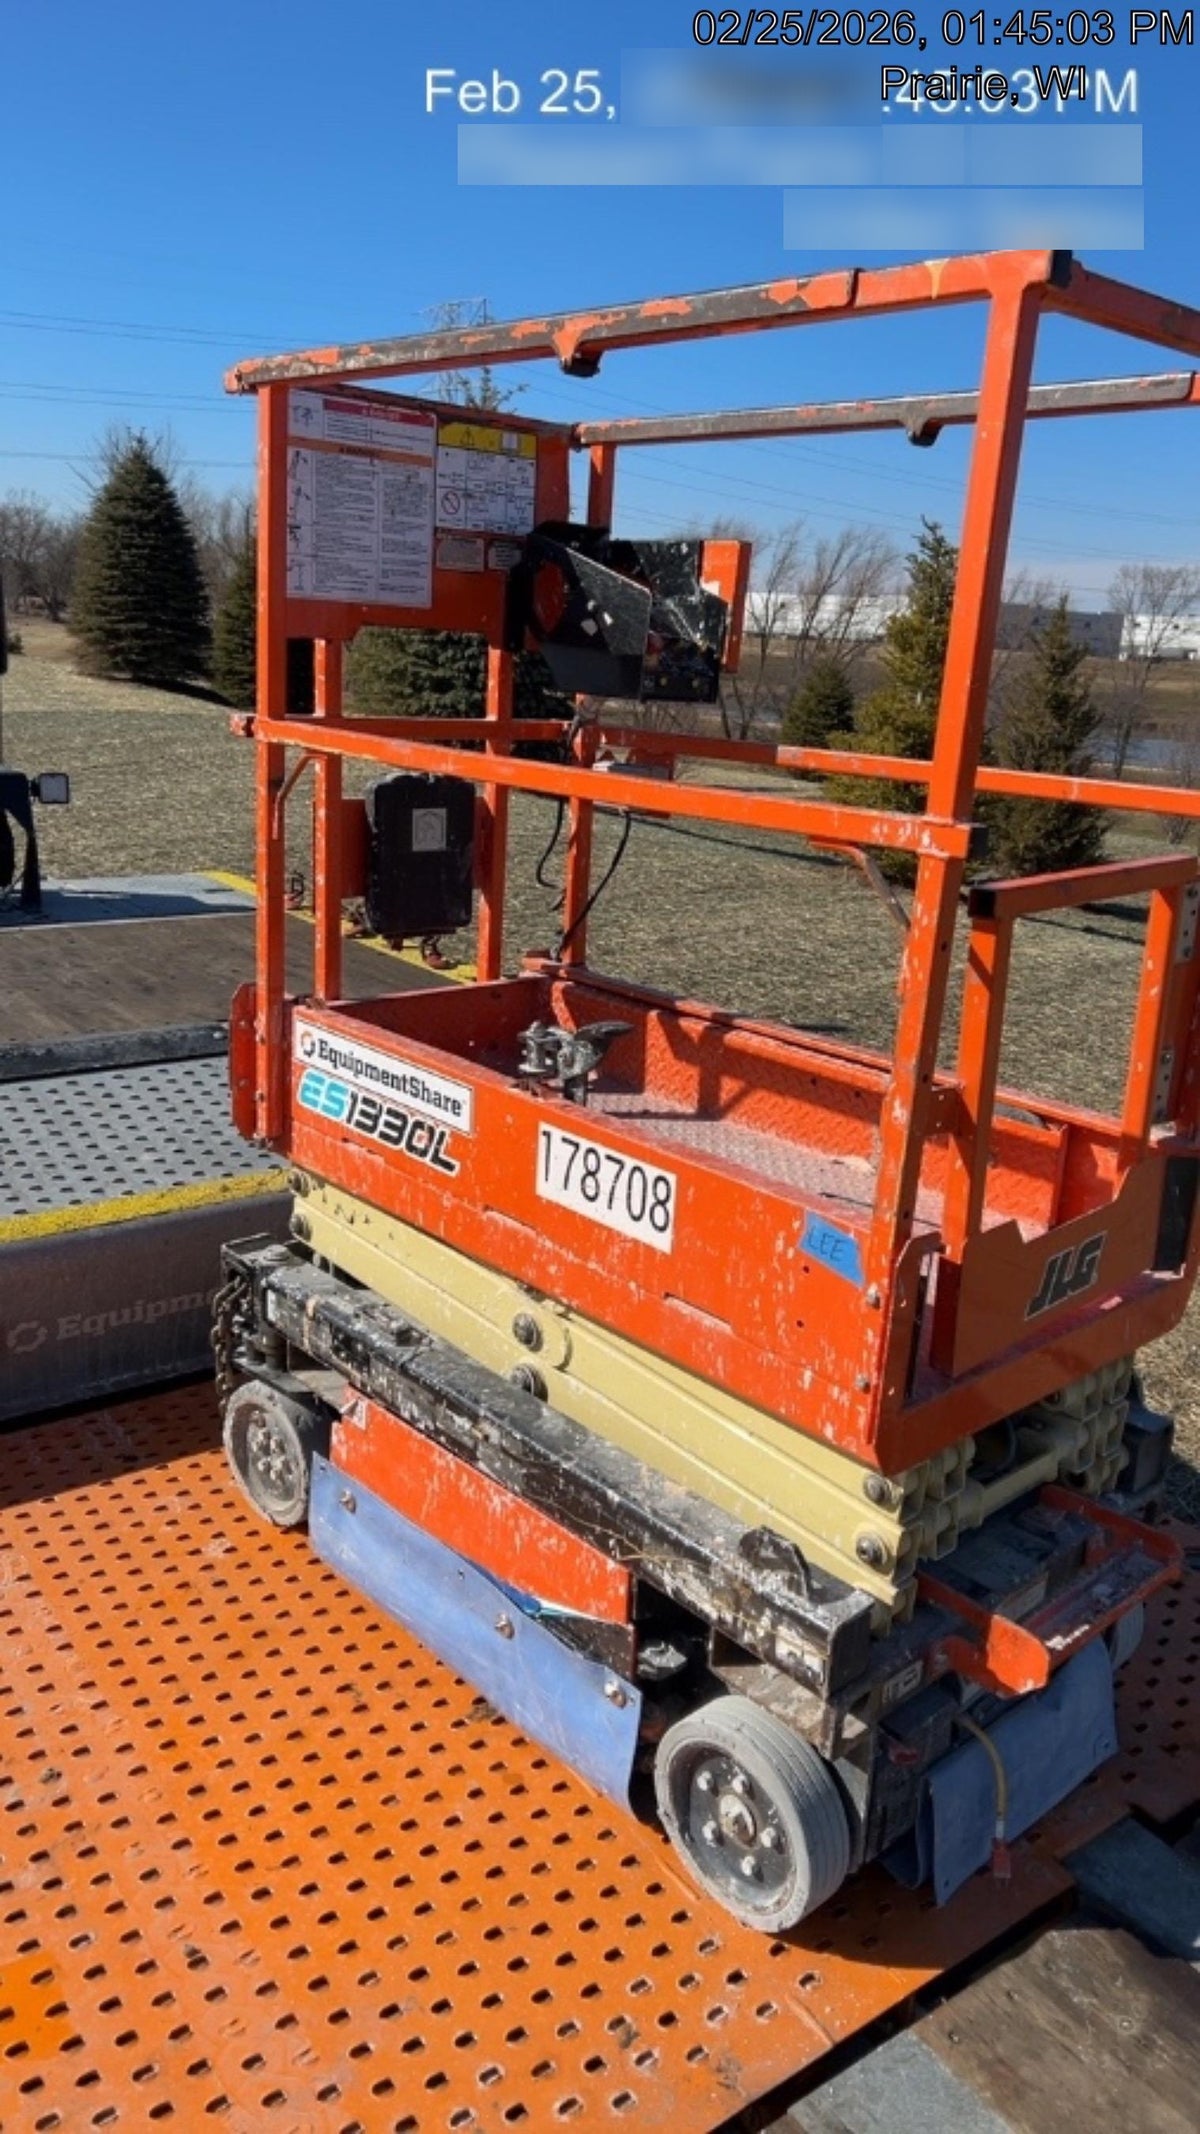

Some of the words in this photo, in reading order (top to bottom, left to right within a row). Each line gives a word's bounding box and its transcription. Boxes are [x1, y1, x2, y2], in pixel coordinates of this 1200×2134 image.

[300, 1071, 458, 1174] ES1330L
[317, 1037, 463, 1118] EquipmentShare
[540, 1130, 672, 1234] 178708
[806, 1230, 846, 1263] LEE
[1024, 1230, 1107, 1321] JLG
